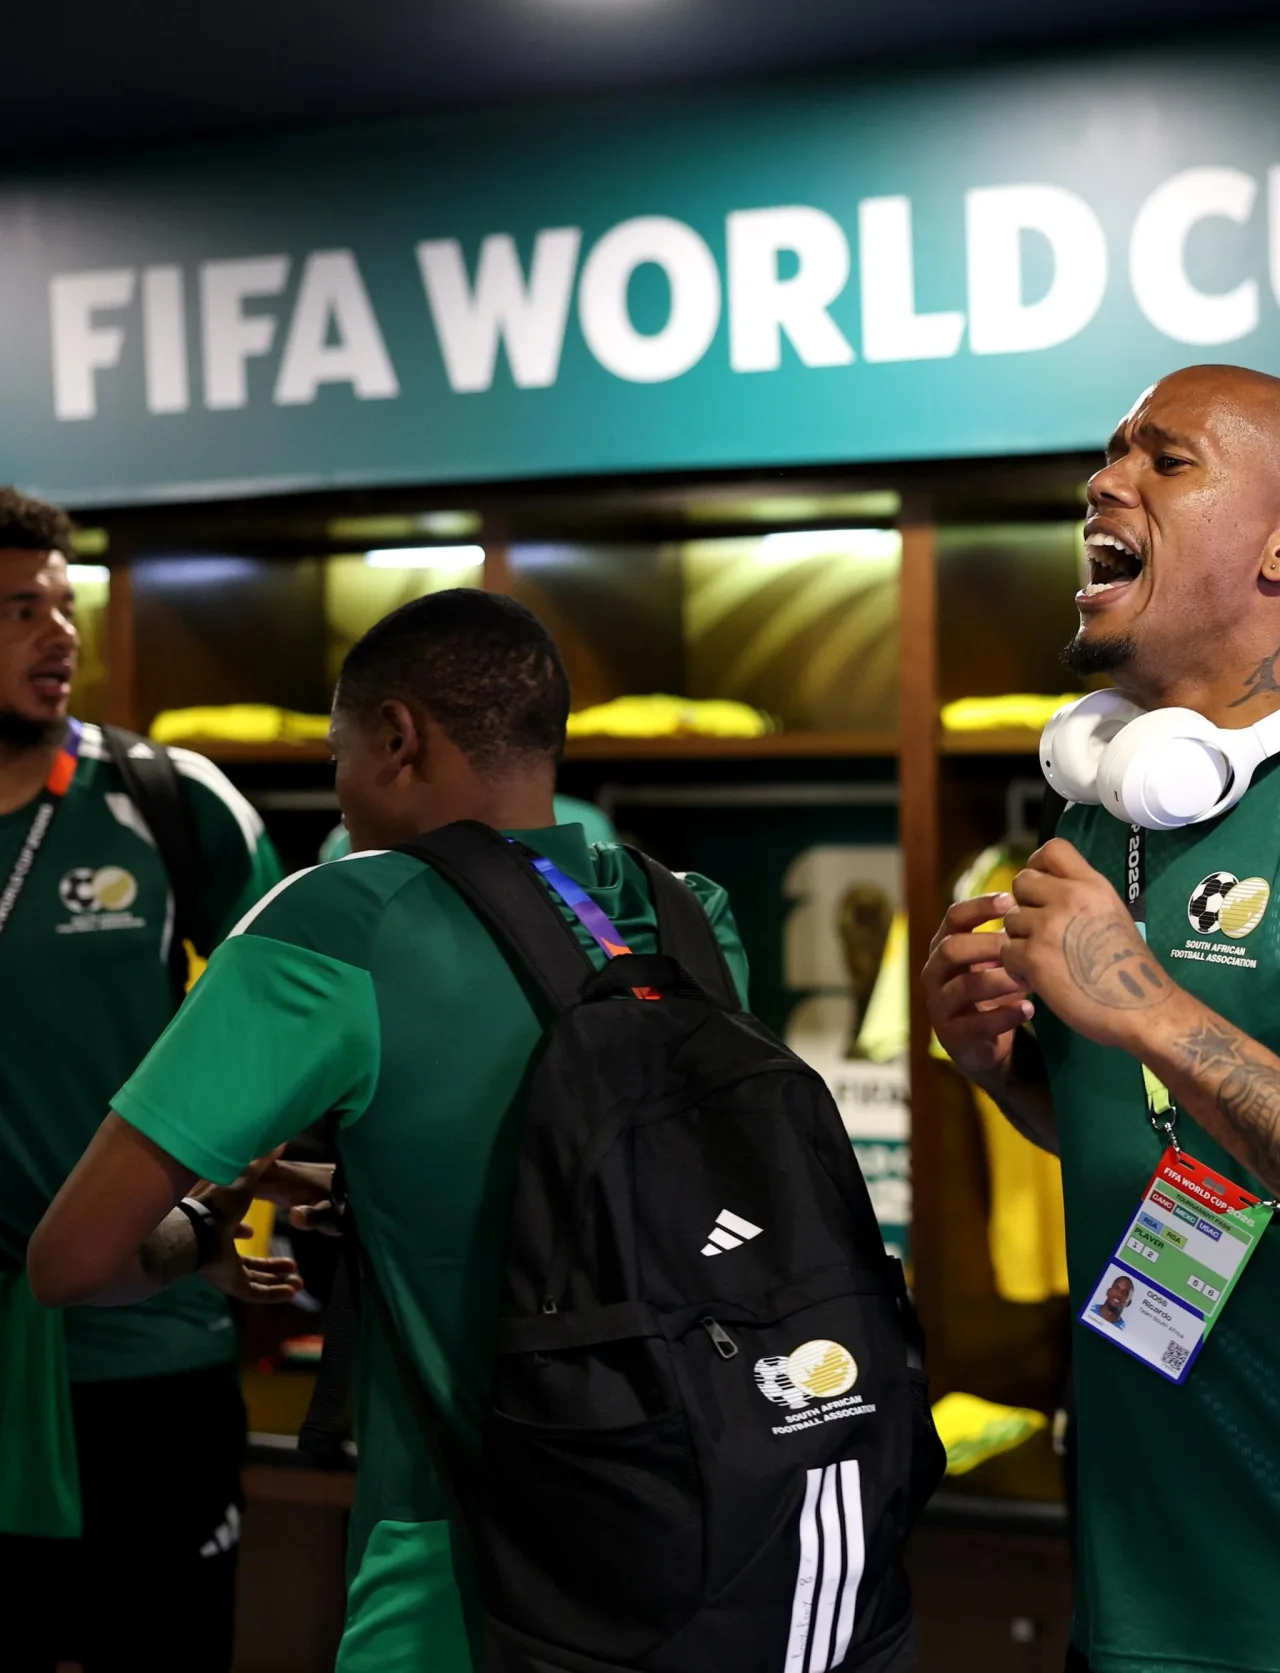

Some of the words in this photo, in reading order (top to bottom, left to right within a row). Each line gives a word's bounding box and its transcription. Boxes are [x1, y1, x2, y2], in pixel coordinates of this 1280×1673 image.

[49, 248, 399, 421] FIFA
[416, 183, 1107, 392] WORLD
[1128, 835, 1140, 902] 2026
[1170, 949, 1205, 961] FOOTBALL
[1205, 953, 1257, 968] ASSOCIATION
[1185, 940, 1211, 950] SOUTH
[1211, 943, 1246, 956] AFRICAN
[1163, 1166, 1181, 1181] FIFA
[1180, 1177, 1212, 1200] WORLD
[1209, 1195, 1228, 1210] CUP
[1225, 1206, 1256, 1228] 2026
[1151, 1192, 1173, 1209] CANC
[1174, 1207, 1196, 1224] MEXC
[1197, 1222, 1220, 1239] USAC
[1174, 1193, 1216, 1221] TOURNAMENT
[1214, 1217, 1232, 1231] PASS
[1133, 1226, 1165, 1250] PLAYER
[1142, 1216, 1159, 1229] RSA
[1165, 1231, 1182, 1244] RSA
[1140, 1298, 1173, 1321] Ricardo
[1145, 1290, 1169, 1307] GOSS
[785, 1408, 821, 1423] SOUTH
[821, 1395, 863, 1412] AFRICAN
[771, 1418, 824, 1435] FOOTBALL
